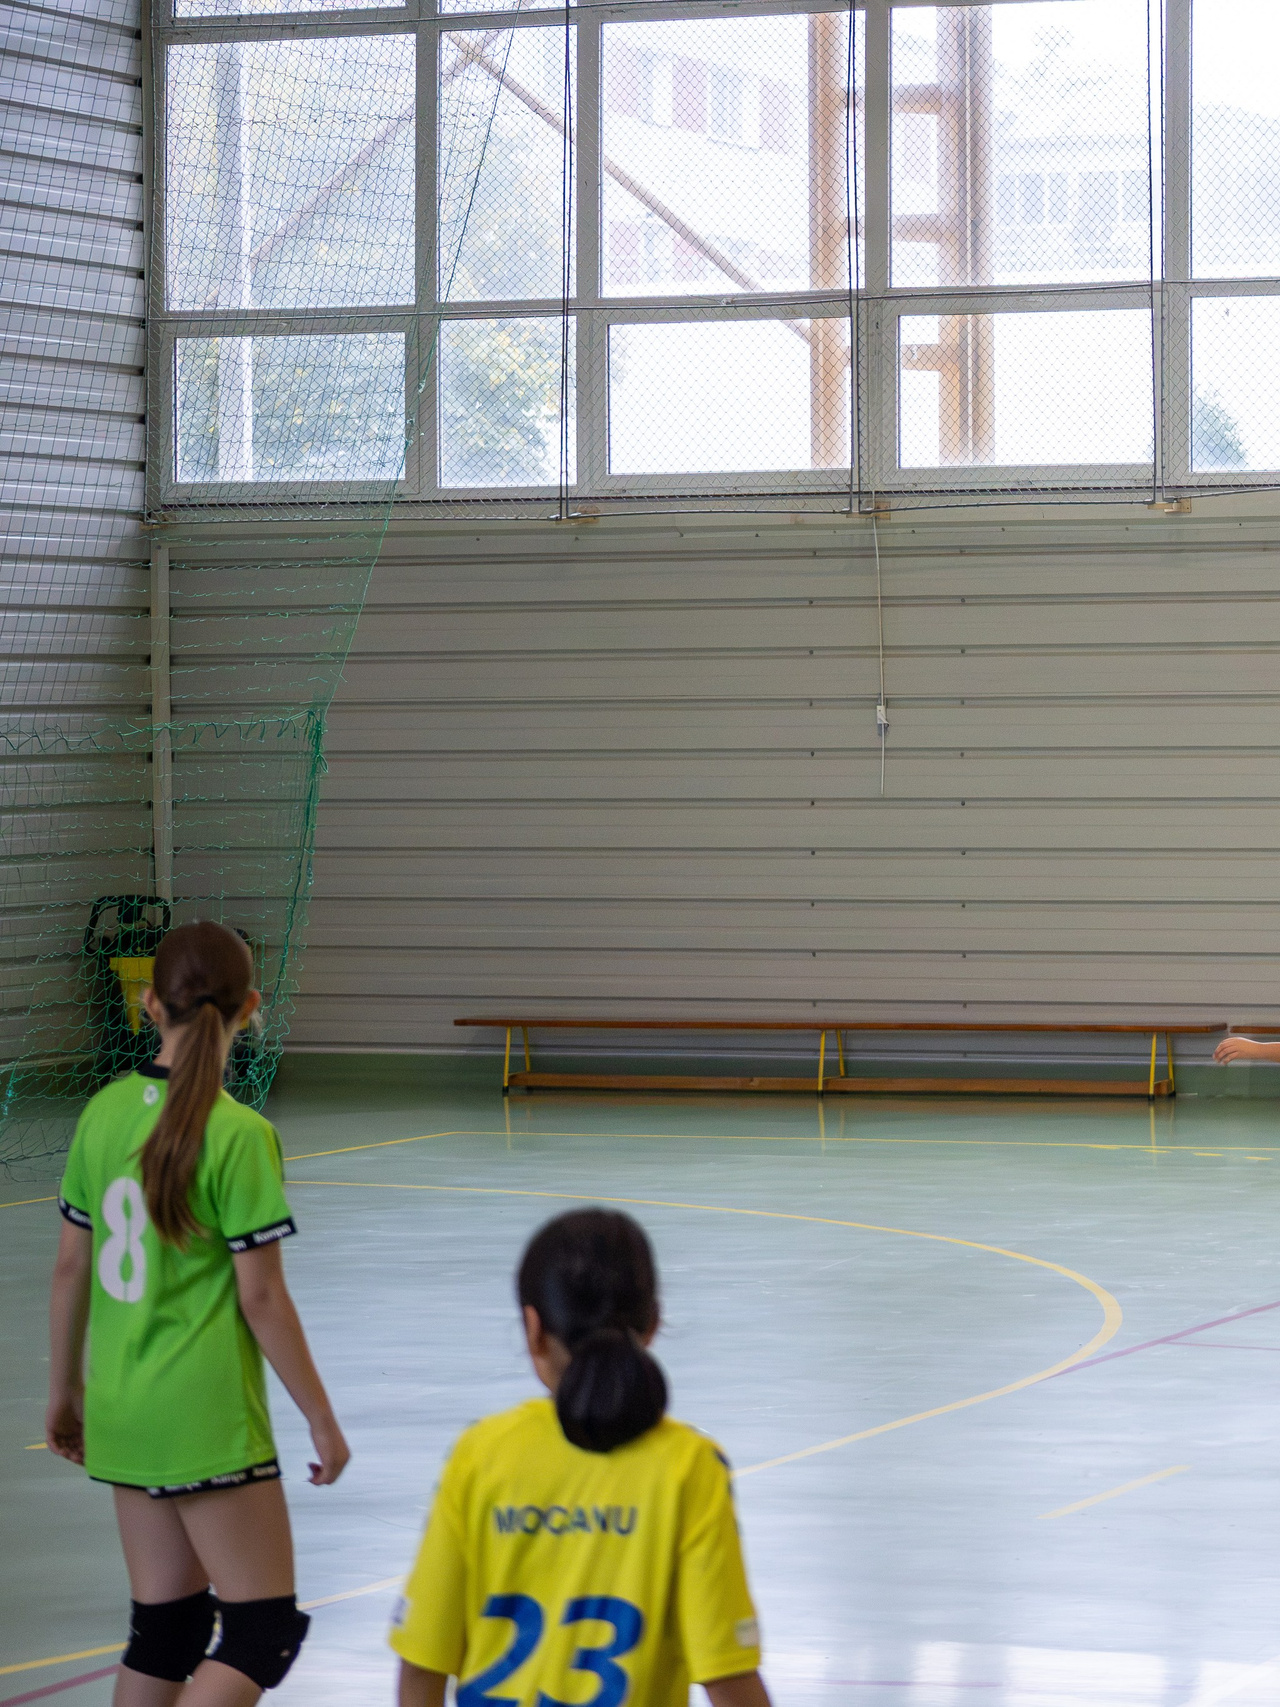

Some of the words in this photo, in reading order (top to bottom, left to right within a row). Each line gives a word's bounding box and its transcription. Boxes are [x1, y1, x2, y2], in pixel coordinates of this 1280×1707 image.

[98, 1176, 149, 1304] 8
[252, 1222, 293, 1245] Kempa
[492, 1504, 638, 1537] MOCANU
[455, 1591, 647, 1707] 23
